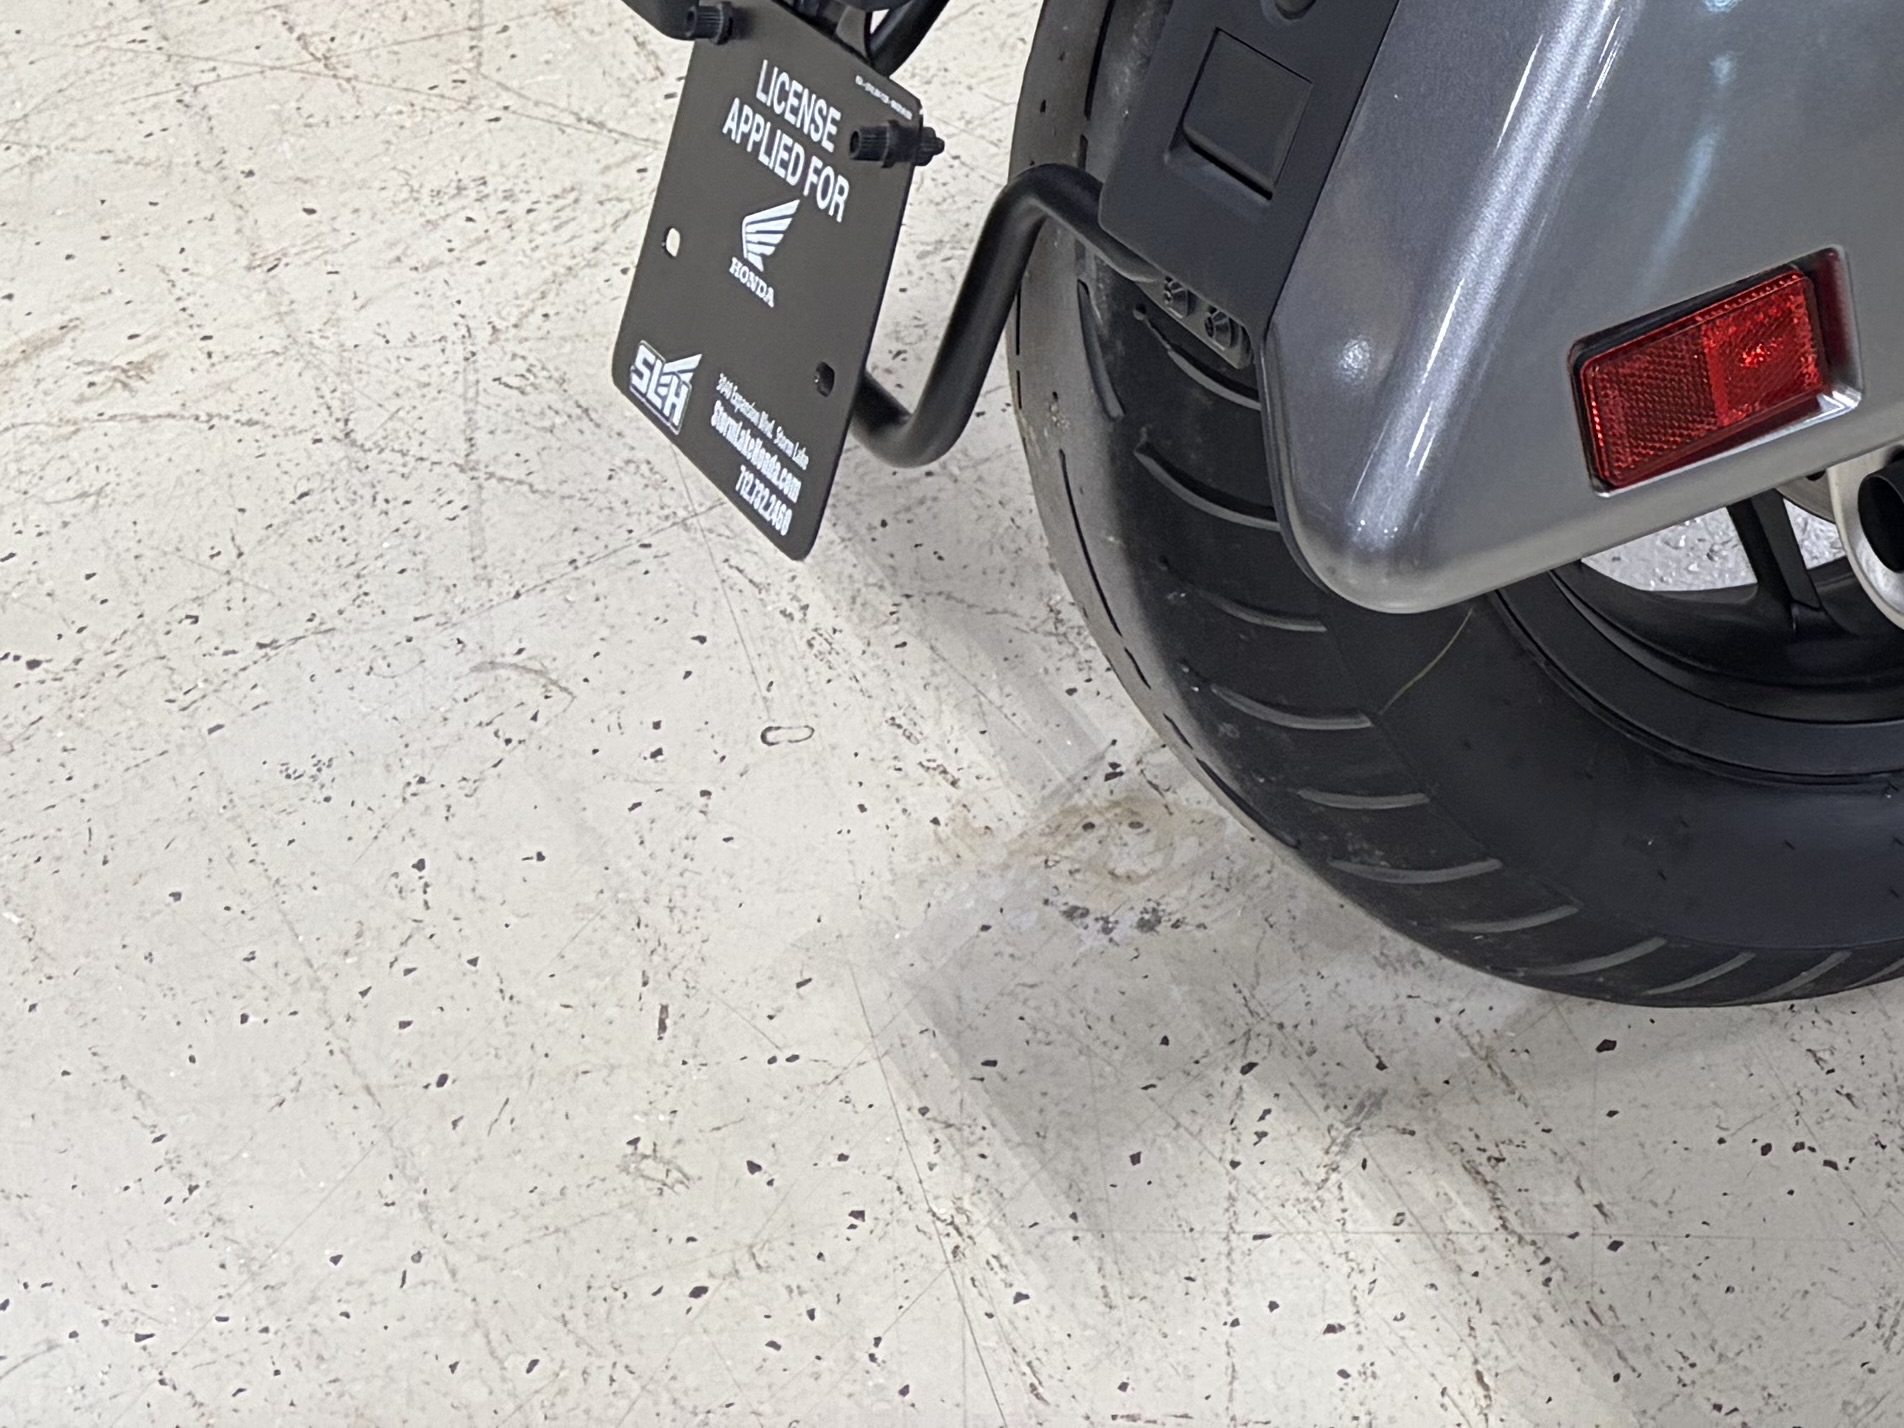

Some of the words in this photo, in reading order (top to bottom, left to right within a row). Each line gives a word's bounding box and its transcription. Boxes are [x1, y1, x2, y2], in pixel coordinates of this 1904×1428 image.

[756, 59, 841, 153] LICENSE
[722, 97, 808, 189] APPLIED
[802, 154, 850, 222] FOR
[729, 256, 775, 308] HONDA
[630, 341, 692, 435] SLH
[711, 399, 802, 504] StormLakeHonda.com
